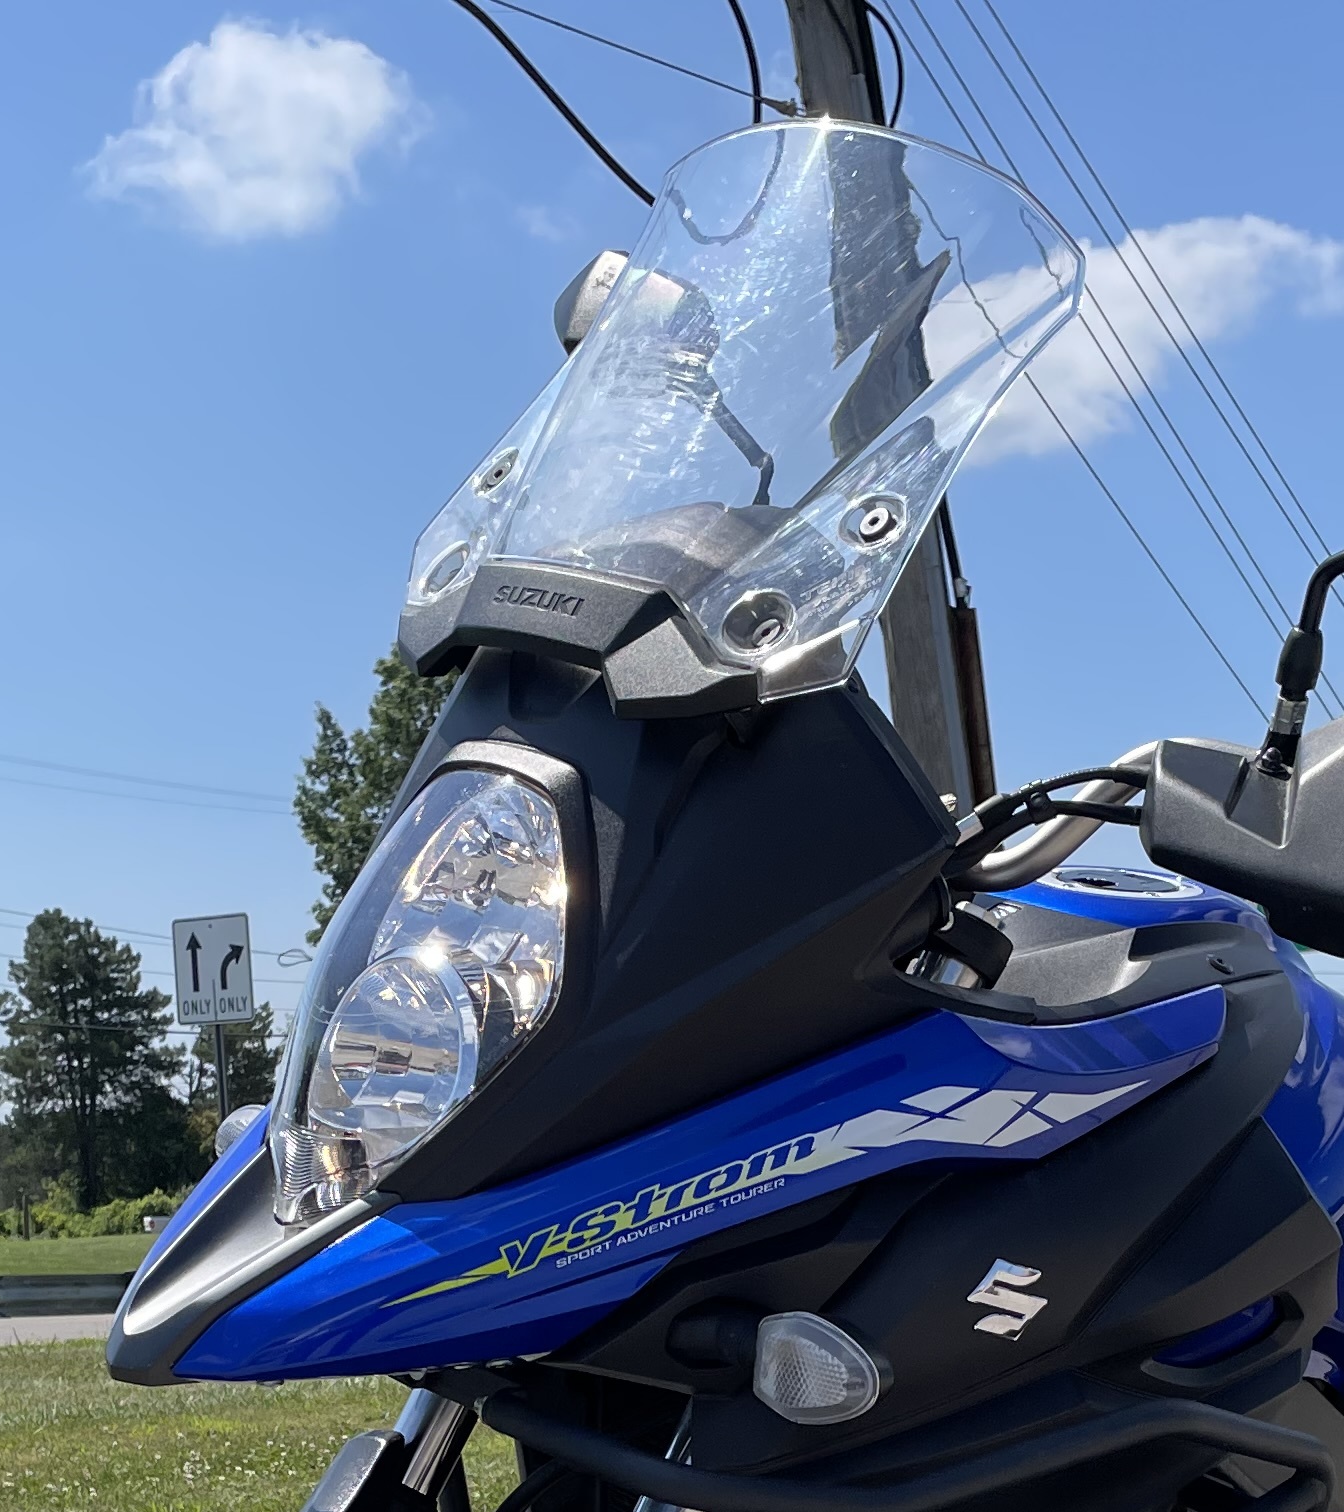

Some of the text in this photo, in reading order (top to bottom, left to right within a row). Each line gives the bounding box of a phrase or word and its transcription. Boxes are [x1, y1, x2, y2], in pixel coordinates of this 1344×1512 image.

[493, 585, 585, 617] SUZUKI
[183, 996, 248, 1016] ONLY ONLY
[500, 1132, 817, 1279] V-Strom
[556, 1178, 785, 1269] SPORT ADVENTURE TOURER
